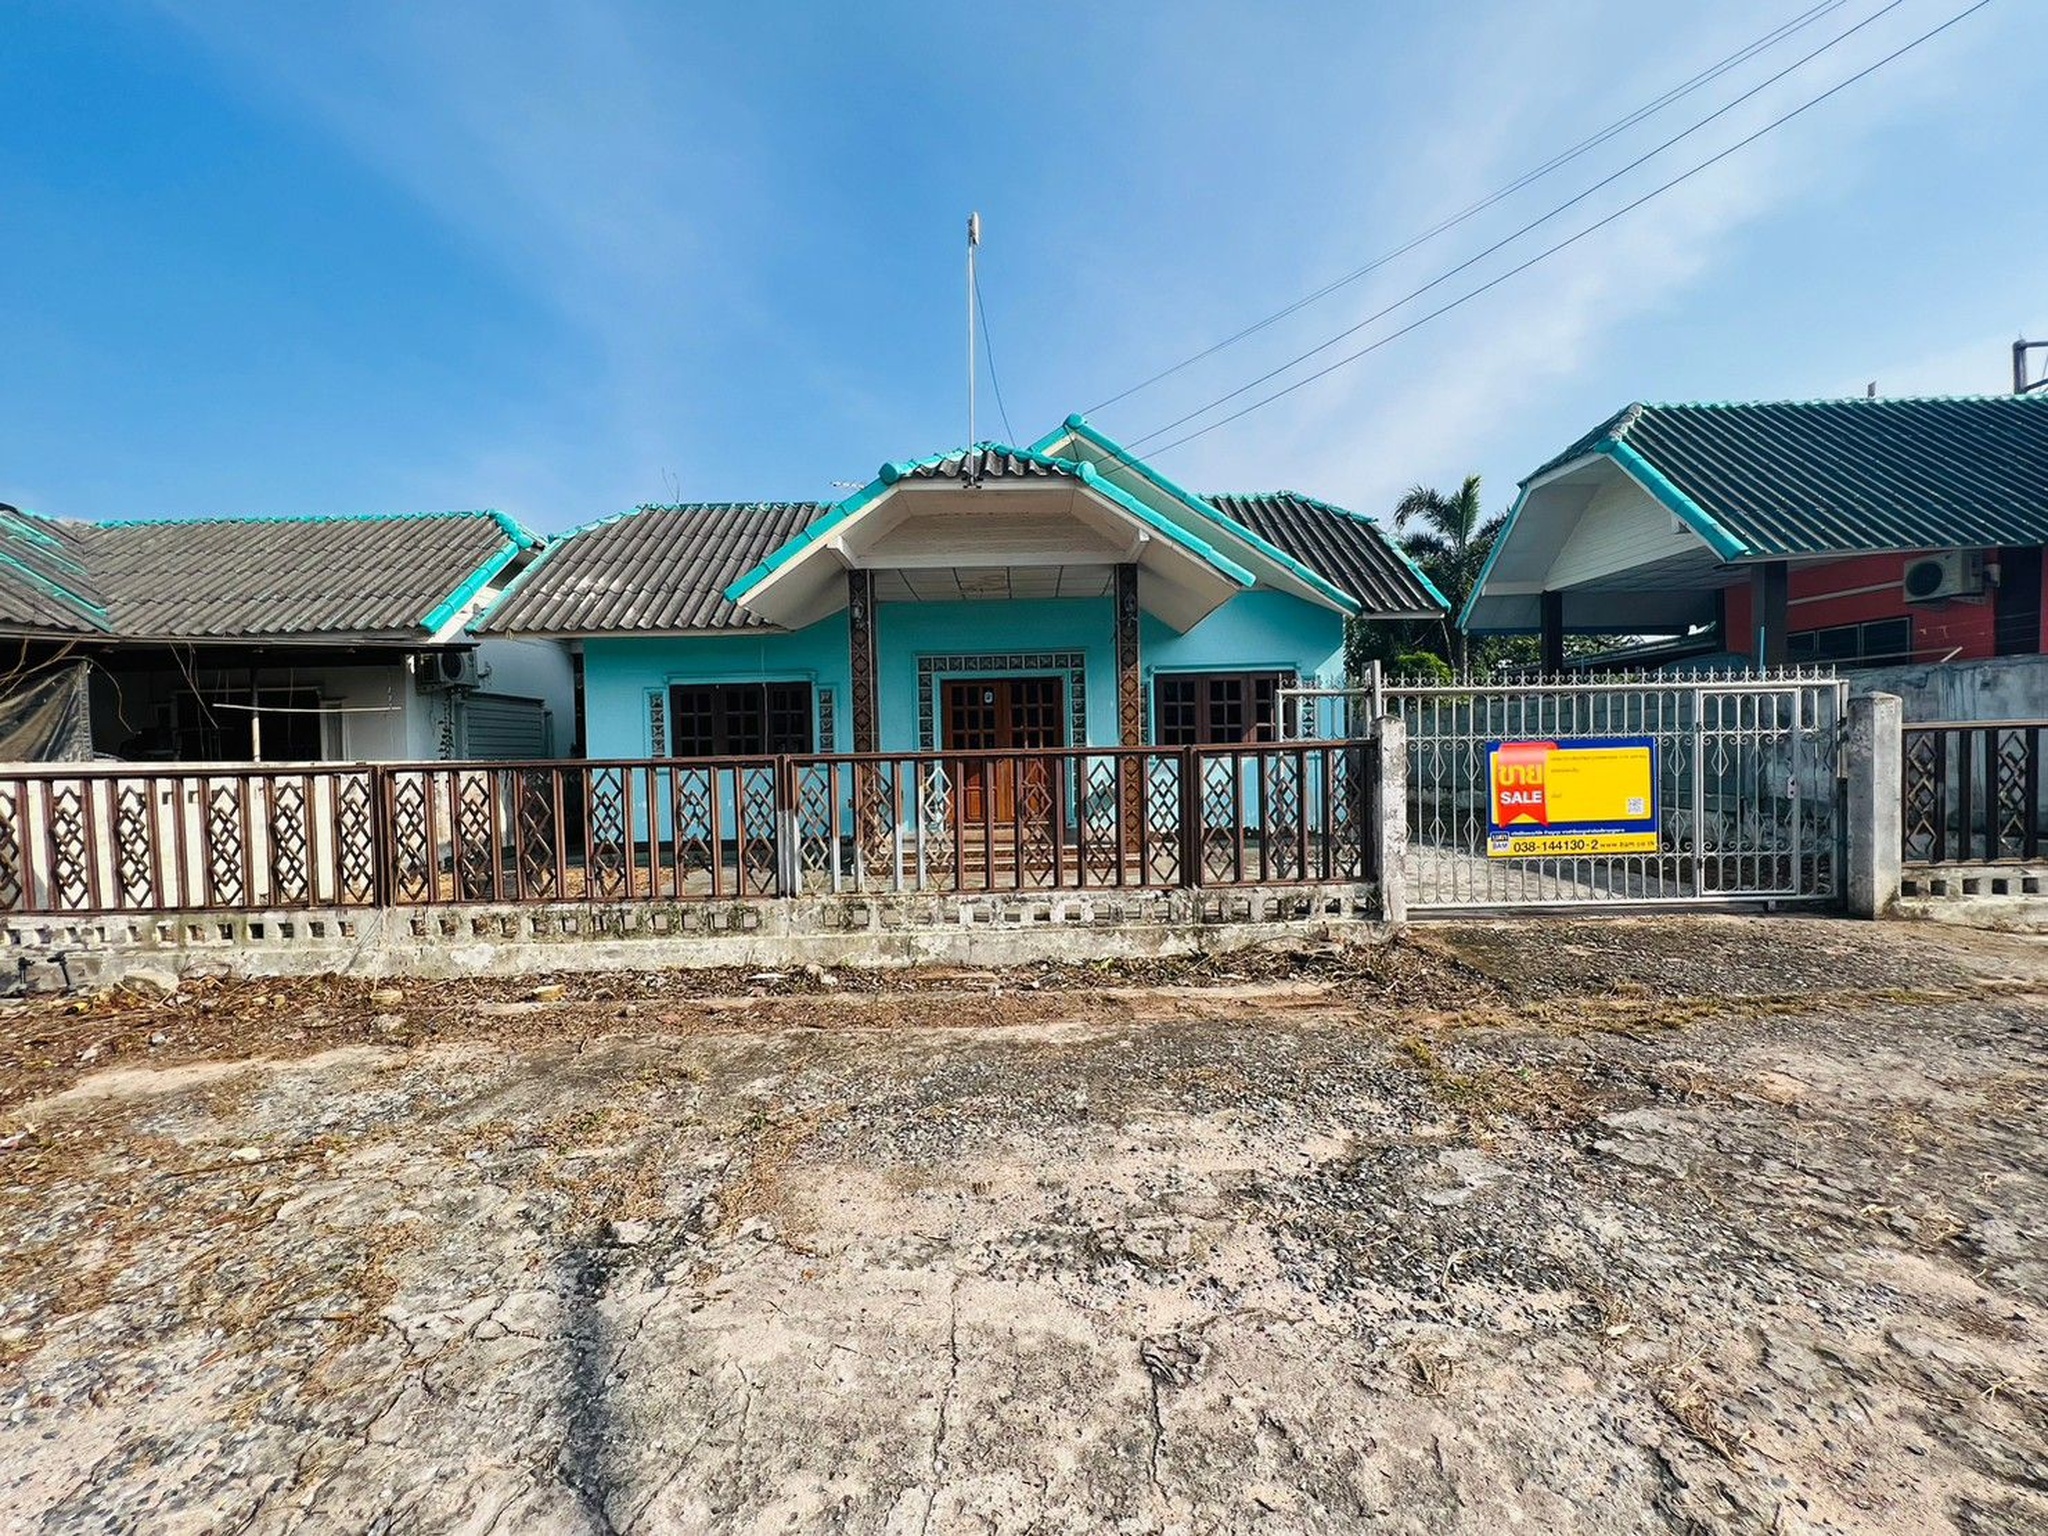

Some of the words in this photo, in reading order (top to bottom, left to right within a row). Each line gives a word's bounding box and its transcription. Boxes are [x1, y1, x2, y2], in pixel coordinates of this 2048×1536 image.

[1498, 763, 1543, 785] ขาย
[1500, 790, 1542, 804] SALE
[1513, 839, 1599, 853] 038-144130-2
